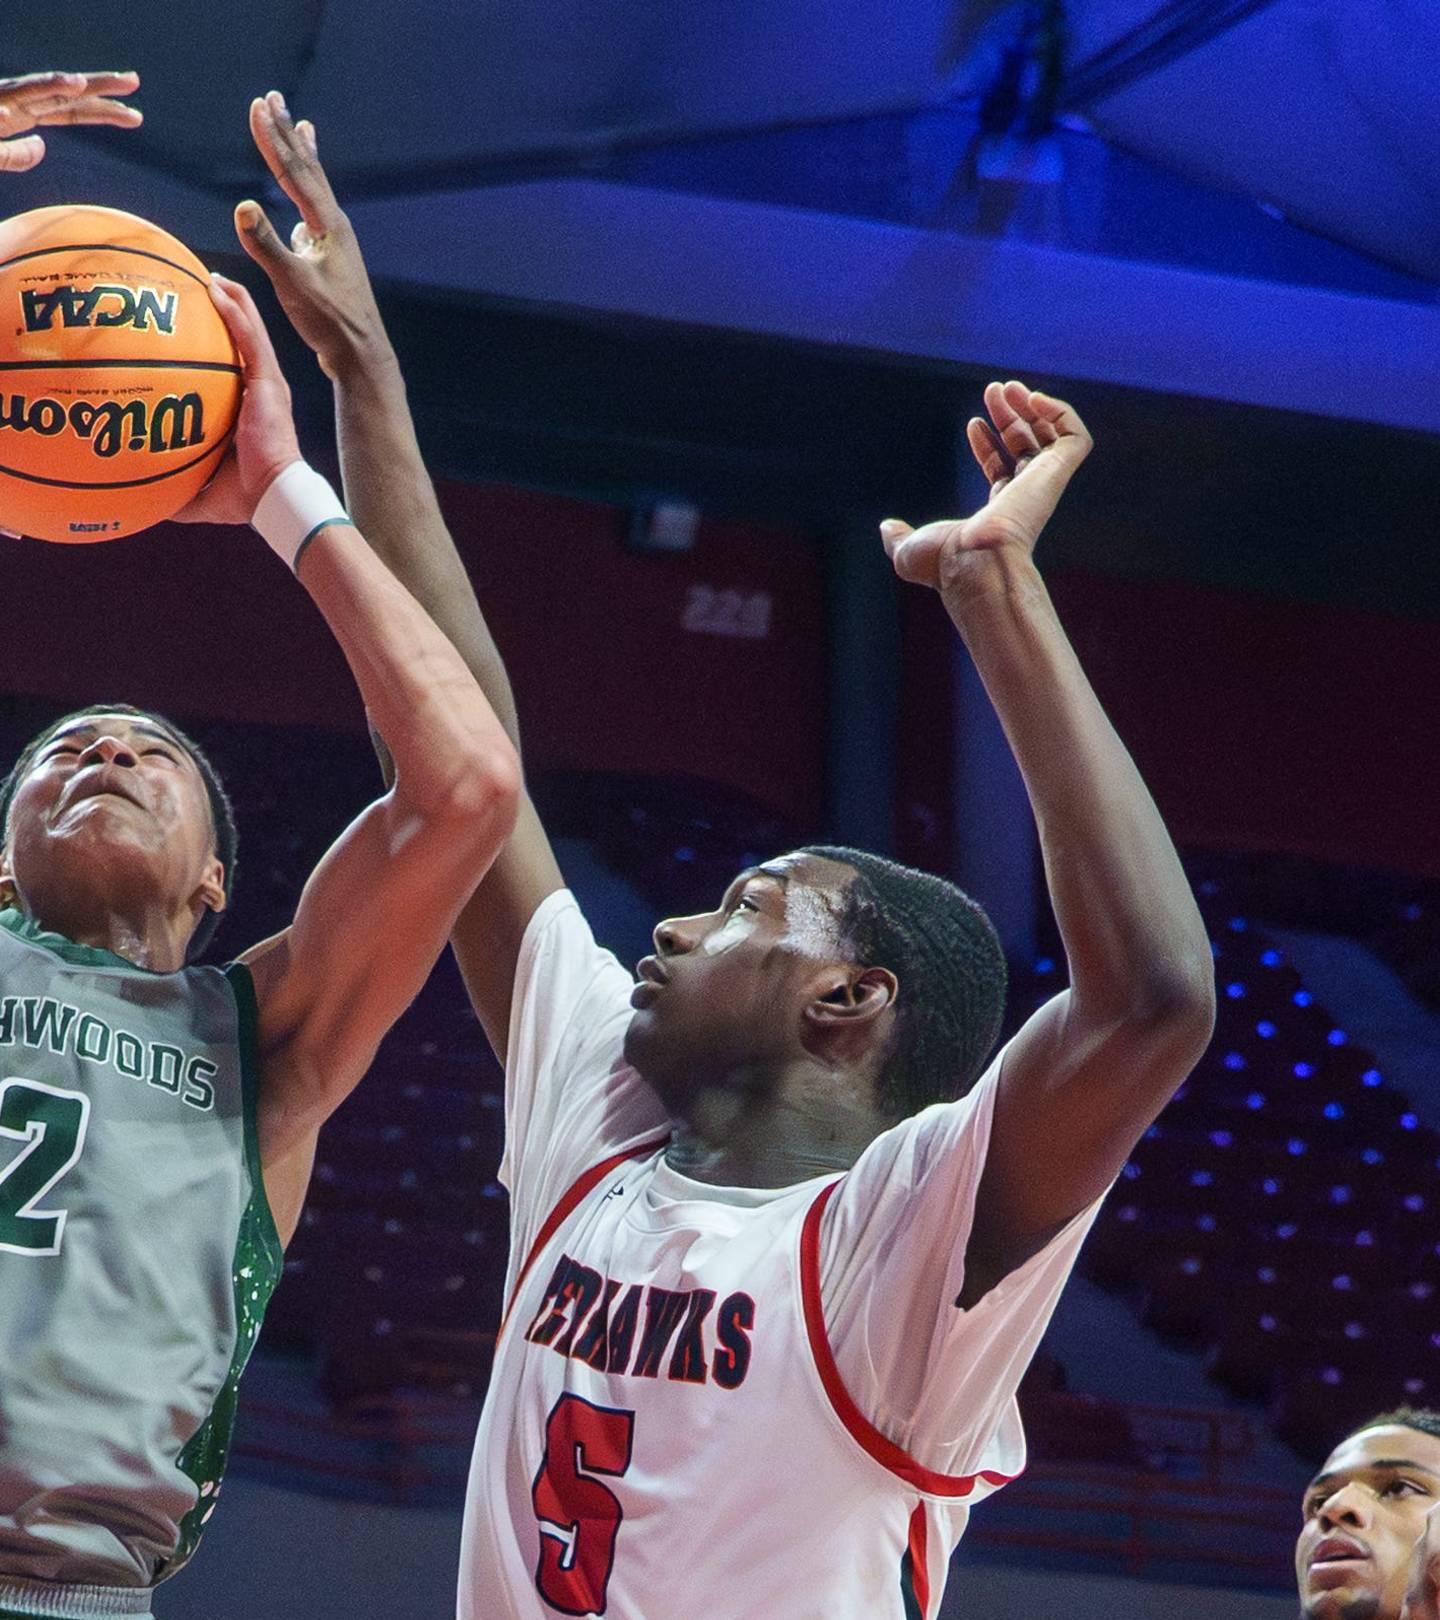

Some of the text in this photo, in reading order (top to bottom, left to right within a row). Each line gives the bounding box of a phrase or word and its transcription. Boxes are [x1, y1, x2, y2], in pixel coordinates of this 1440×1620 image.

[20, 282, 179, 335] NCAA
[524, 1253, 756, 1390] EDHAWKS
[532, 1391, 635, 1616] 5
